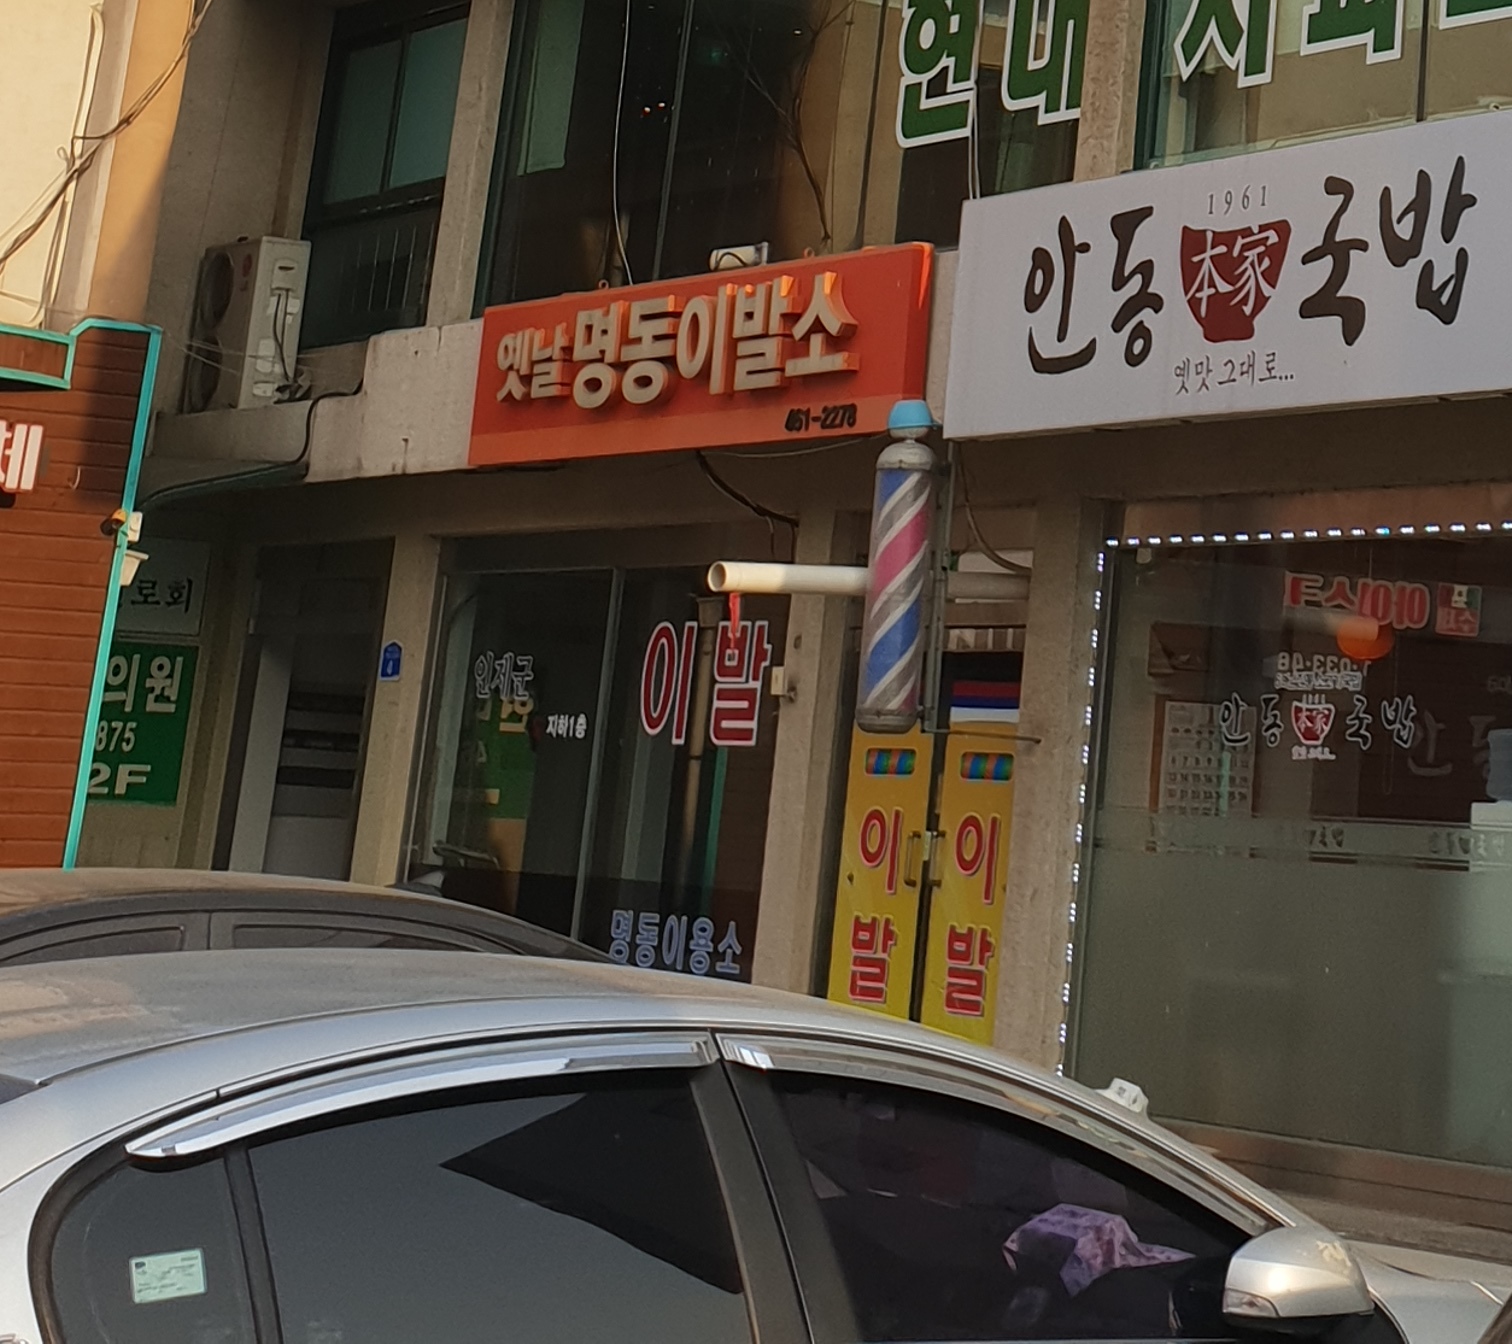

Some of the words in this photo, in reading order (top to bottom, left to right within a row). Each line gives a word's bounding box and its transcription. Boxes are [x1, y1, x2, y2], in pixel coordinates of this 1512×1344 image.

[1207, 183, 1269, 216] 1961
[496, 321, 572, 403] 옛날
[572, 270, 861, 410] 명동이발소
[639, 618, 773, 748] 이발
[87, 762, 151, 797] 2F
[609, 909, 742, 976] 명동이용소
